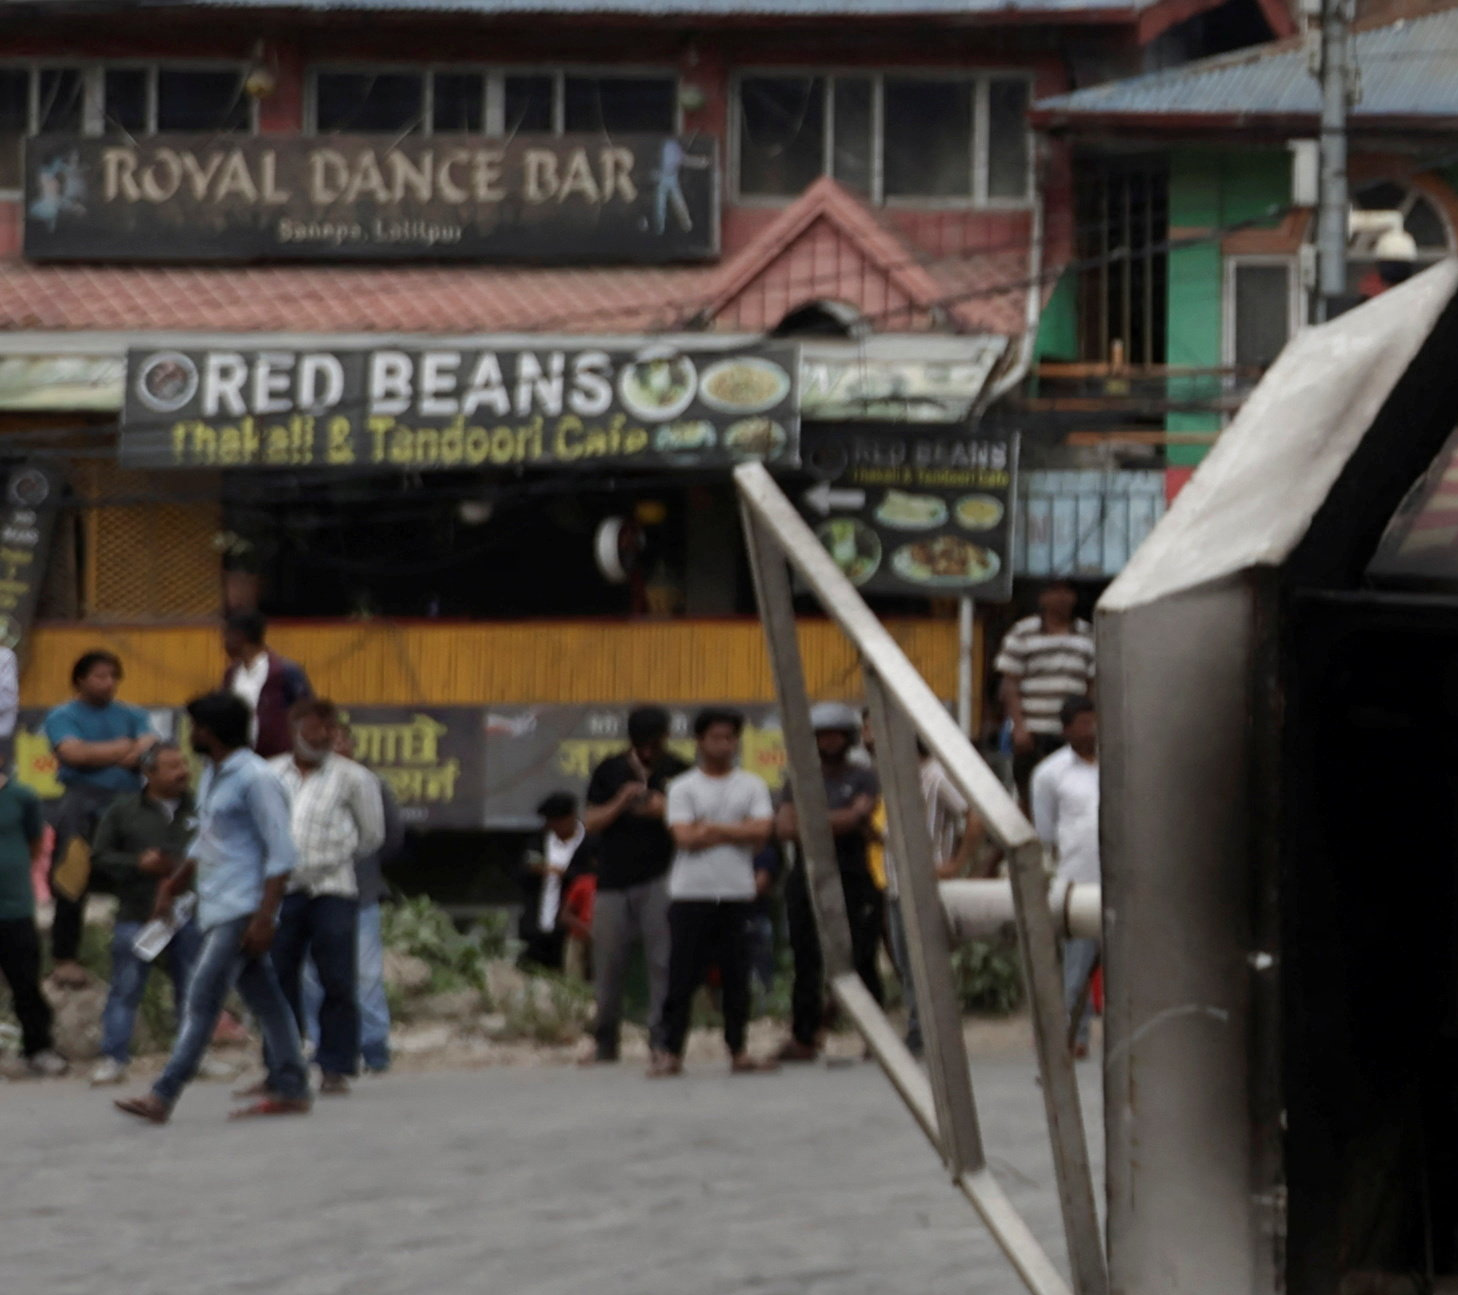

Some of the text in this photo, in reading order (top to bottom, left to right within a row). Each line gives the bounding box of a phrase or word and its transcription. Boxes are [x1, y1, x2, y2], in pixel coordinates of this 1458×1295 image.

[103, 147, 638, 204] ROYAL DANCE BAR
[203, 351, 613, 417] RED BEANS
[367, 413, 544, 465] Tandoori
[554, 412, 649, 462] Cafe
